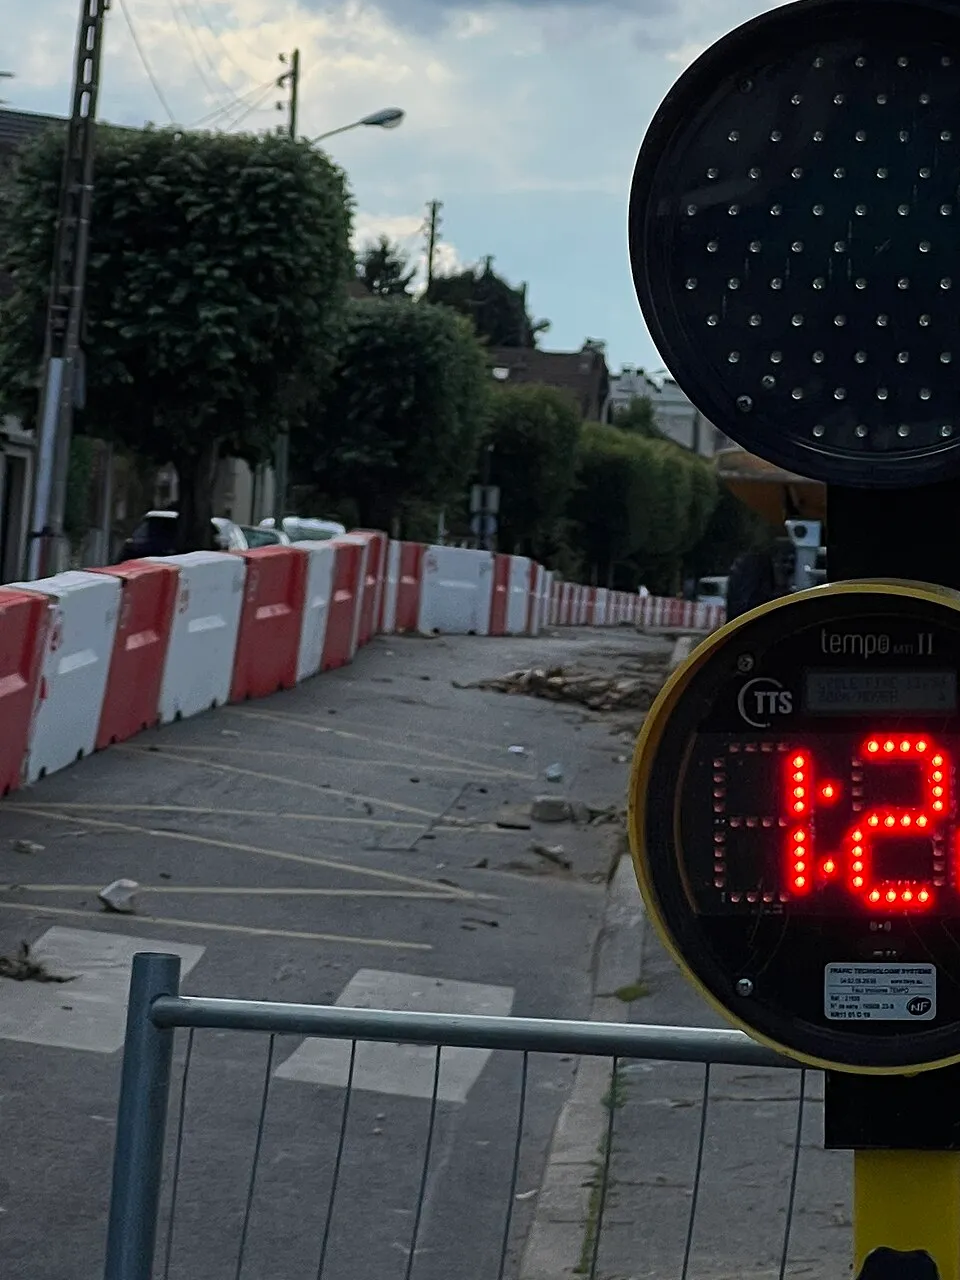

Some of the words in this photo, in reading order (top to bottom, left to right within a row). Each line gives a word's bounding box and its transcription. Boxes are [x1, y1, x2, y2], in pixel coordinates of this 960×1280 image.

[820, 628, 890, 660] tempo
[753, 690, 794, 715] TTS
[910, 1001, 930, 1012] NF
